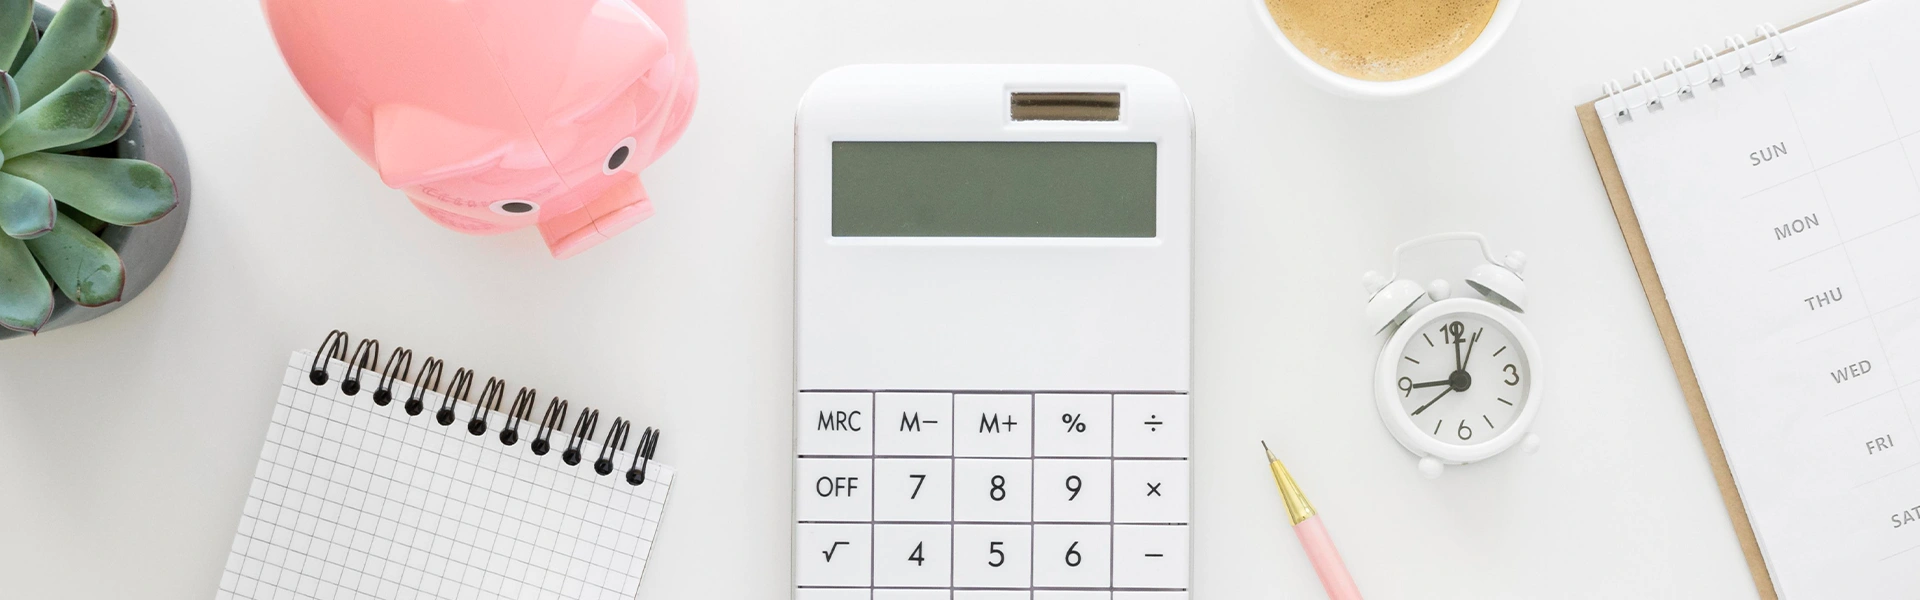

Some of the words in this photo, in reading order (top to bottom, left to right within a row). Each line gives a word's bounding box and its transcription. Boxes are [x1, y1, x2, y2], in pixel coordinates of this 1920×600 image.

[1750, 142, 1787, 166] SUN
[1774, 214, 1819, 240] MON
[1804, 287, 1842, 311] THU
[1439, 321, 1466, 344] 12
[1503, 364, 1519, 386] 3
[1831, 360, 1871, 383] WED
[1398, 376, 1413, 398] 9
[818, 411, 861, 431] MRC
[980, 413, 1017, 433] M+
[1062, 414, 1086, 432] %
[1458, 420, 1472, 440] 6
[1866, 435, 1893, 454] FRI
[816, 476, 858, 497] OFF
[910, 475, 926, 499] 7
[990, 475, 1005, 501] 8
[1066, 475, 1082, 501] 9
[1892, 506, 1920, 528] SAT
[908, 541, 924, 566] 4
[989, 542, 1004, 567] 5
[1065, 541, 1081, 567] 6
